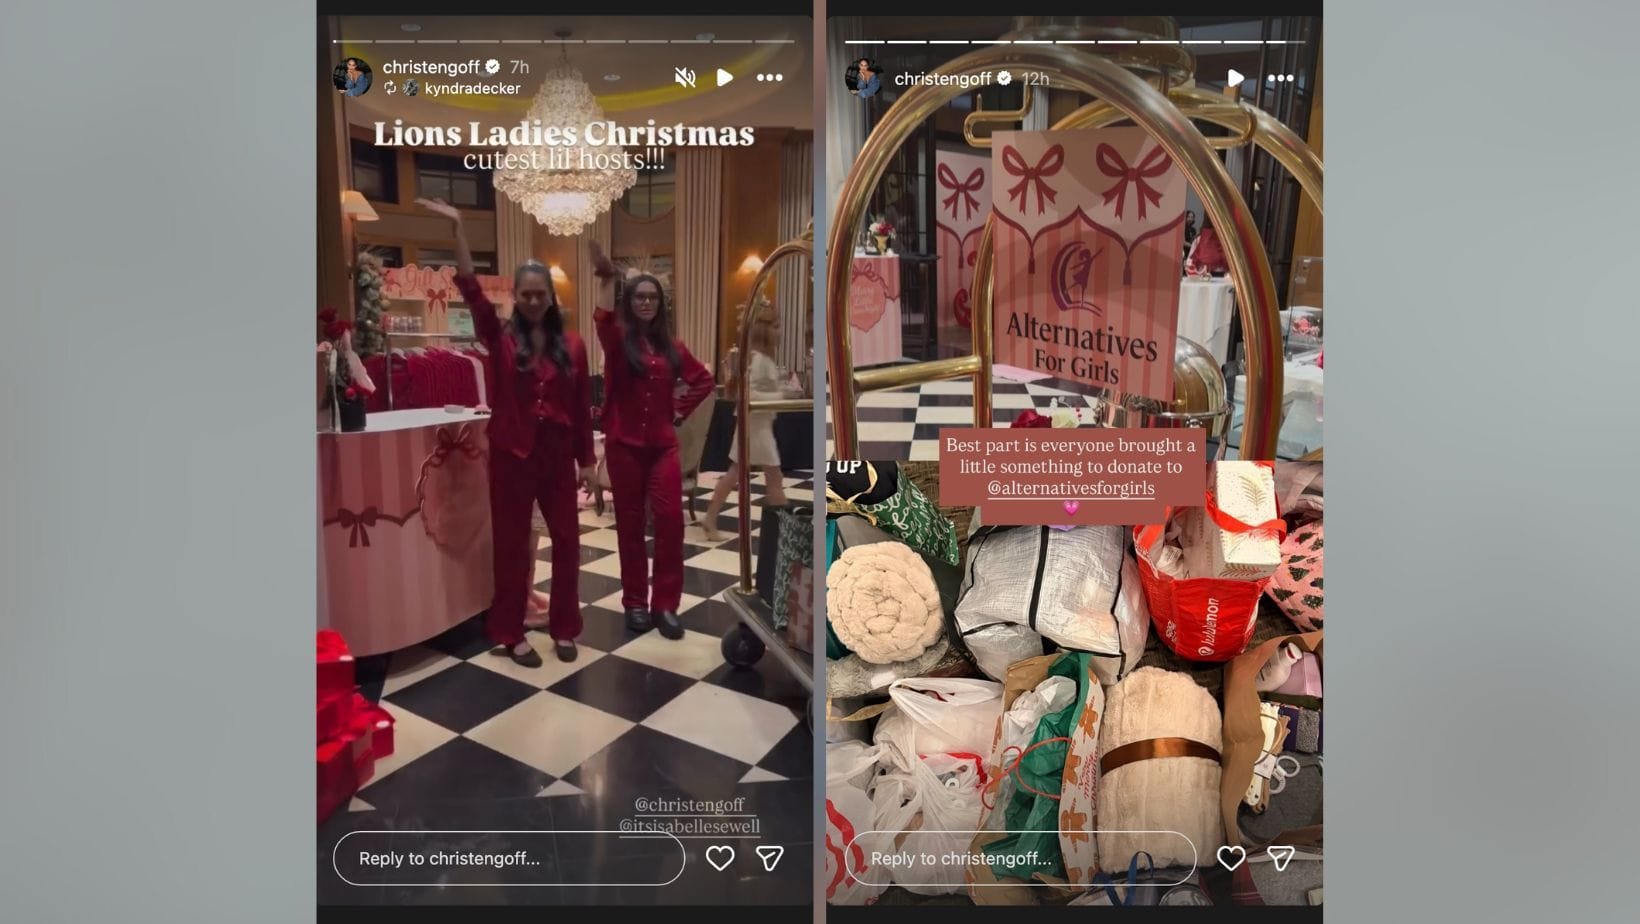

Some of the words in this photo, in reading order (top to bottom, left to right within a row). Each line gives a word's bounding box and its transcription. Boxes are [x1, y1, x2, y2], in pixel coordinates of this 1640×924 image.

[1006, 311, 1158, 362] Alternatives
[1035, 348, 1066, 373] For
[1071, 356, 1119, 385] Girls
